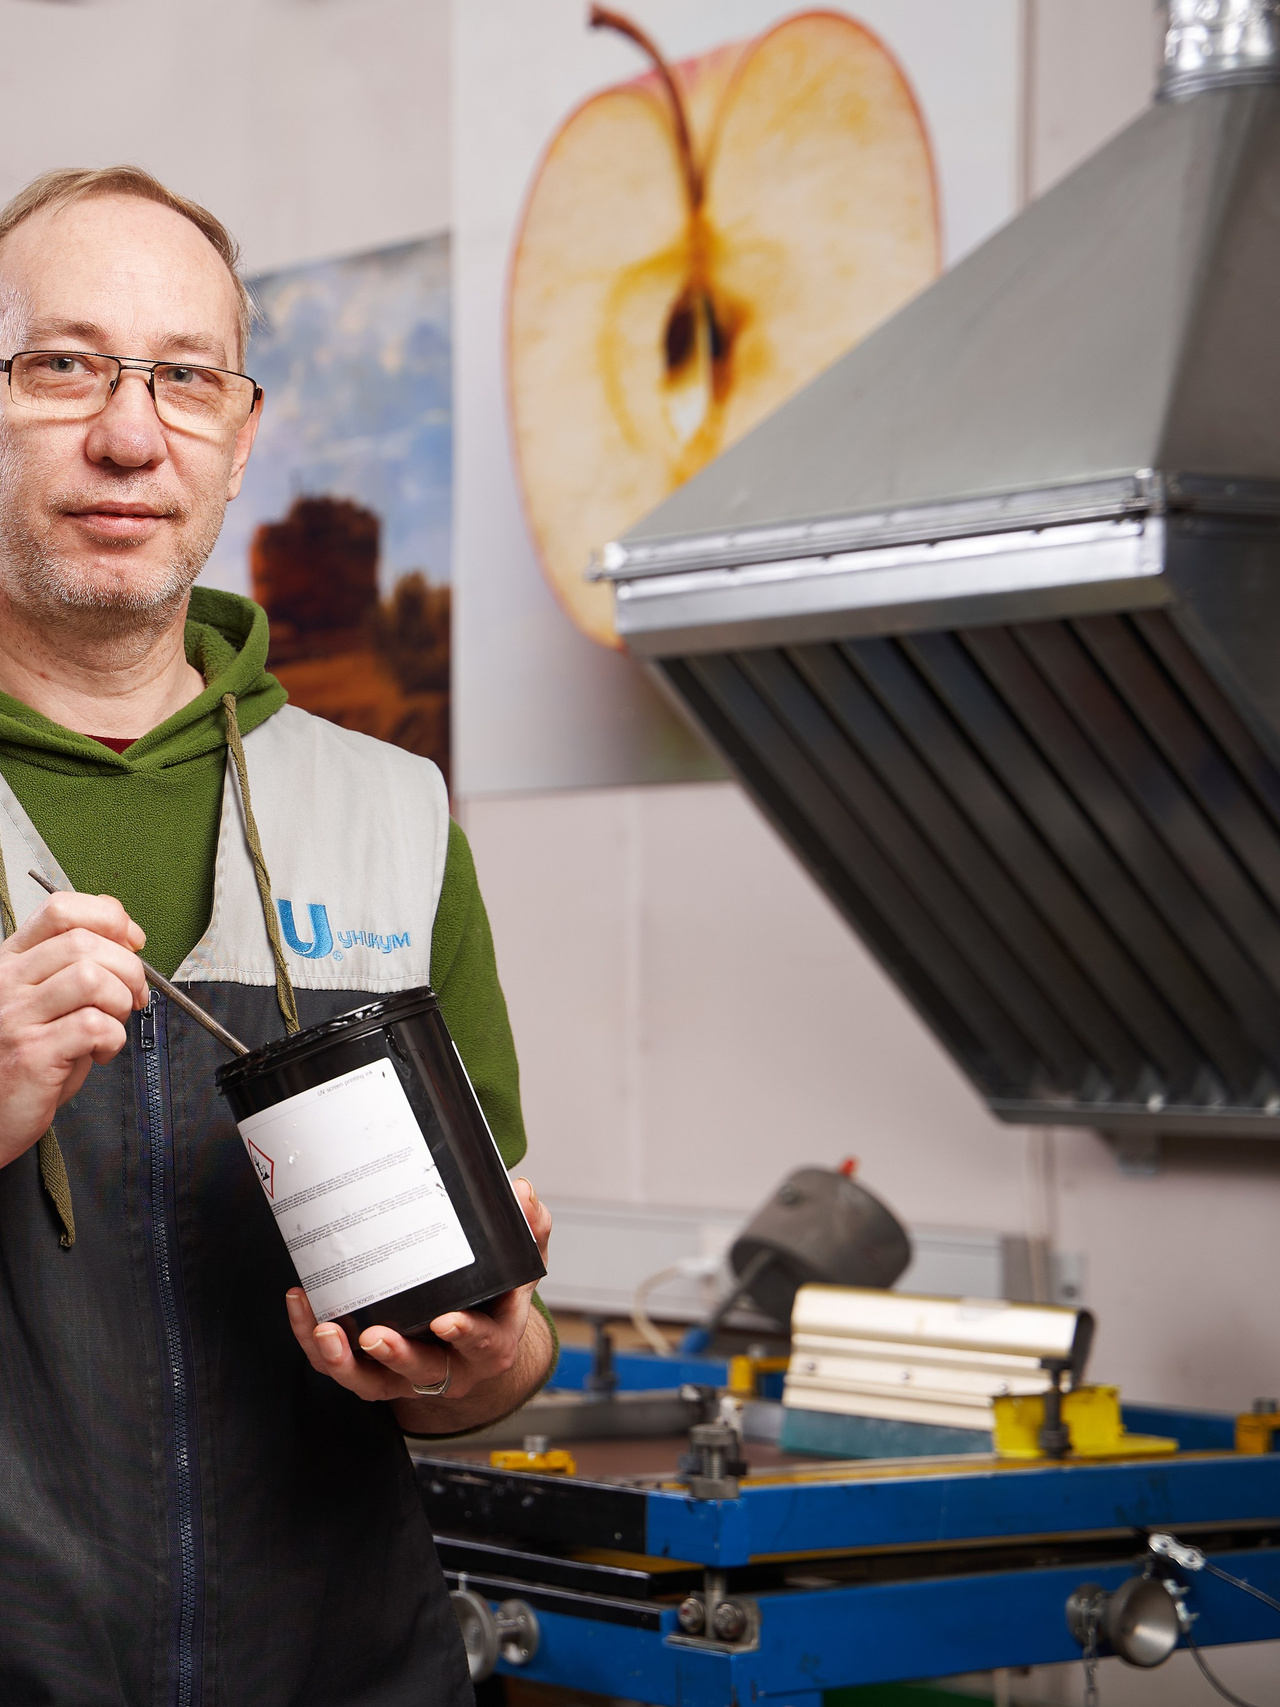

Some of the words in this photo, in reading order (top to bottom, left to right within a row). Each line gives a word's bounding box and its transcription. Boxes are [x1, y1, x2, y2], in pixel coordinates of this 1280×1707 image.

[326, 1082, 344, 1092] screen
[344, 1074, 365, 1086] printing
[378, 1271, 434, 1297] www.eptanova.com
